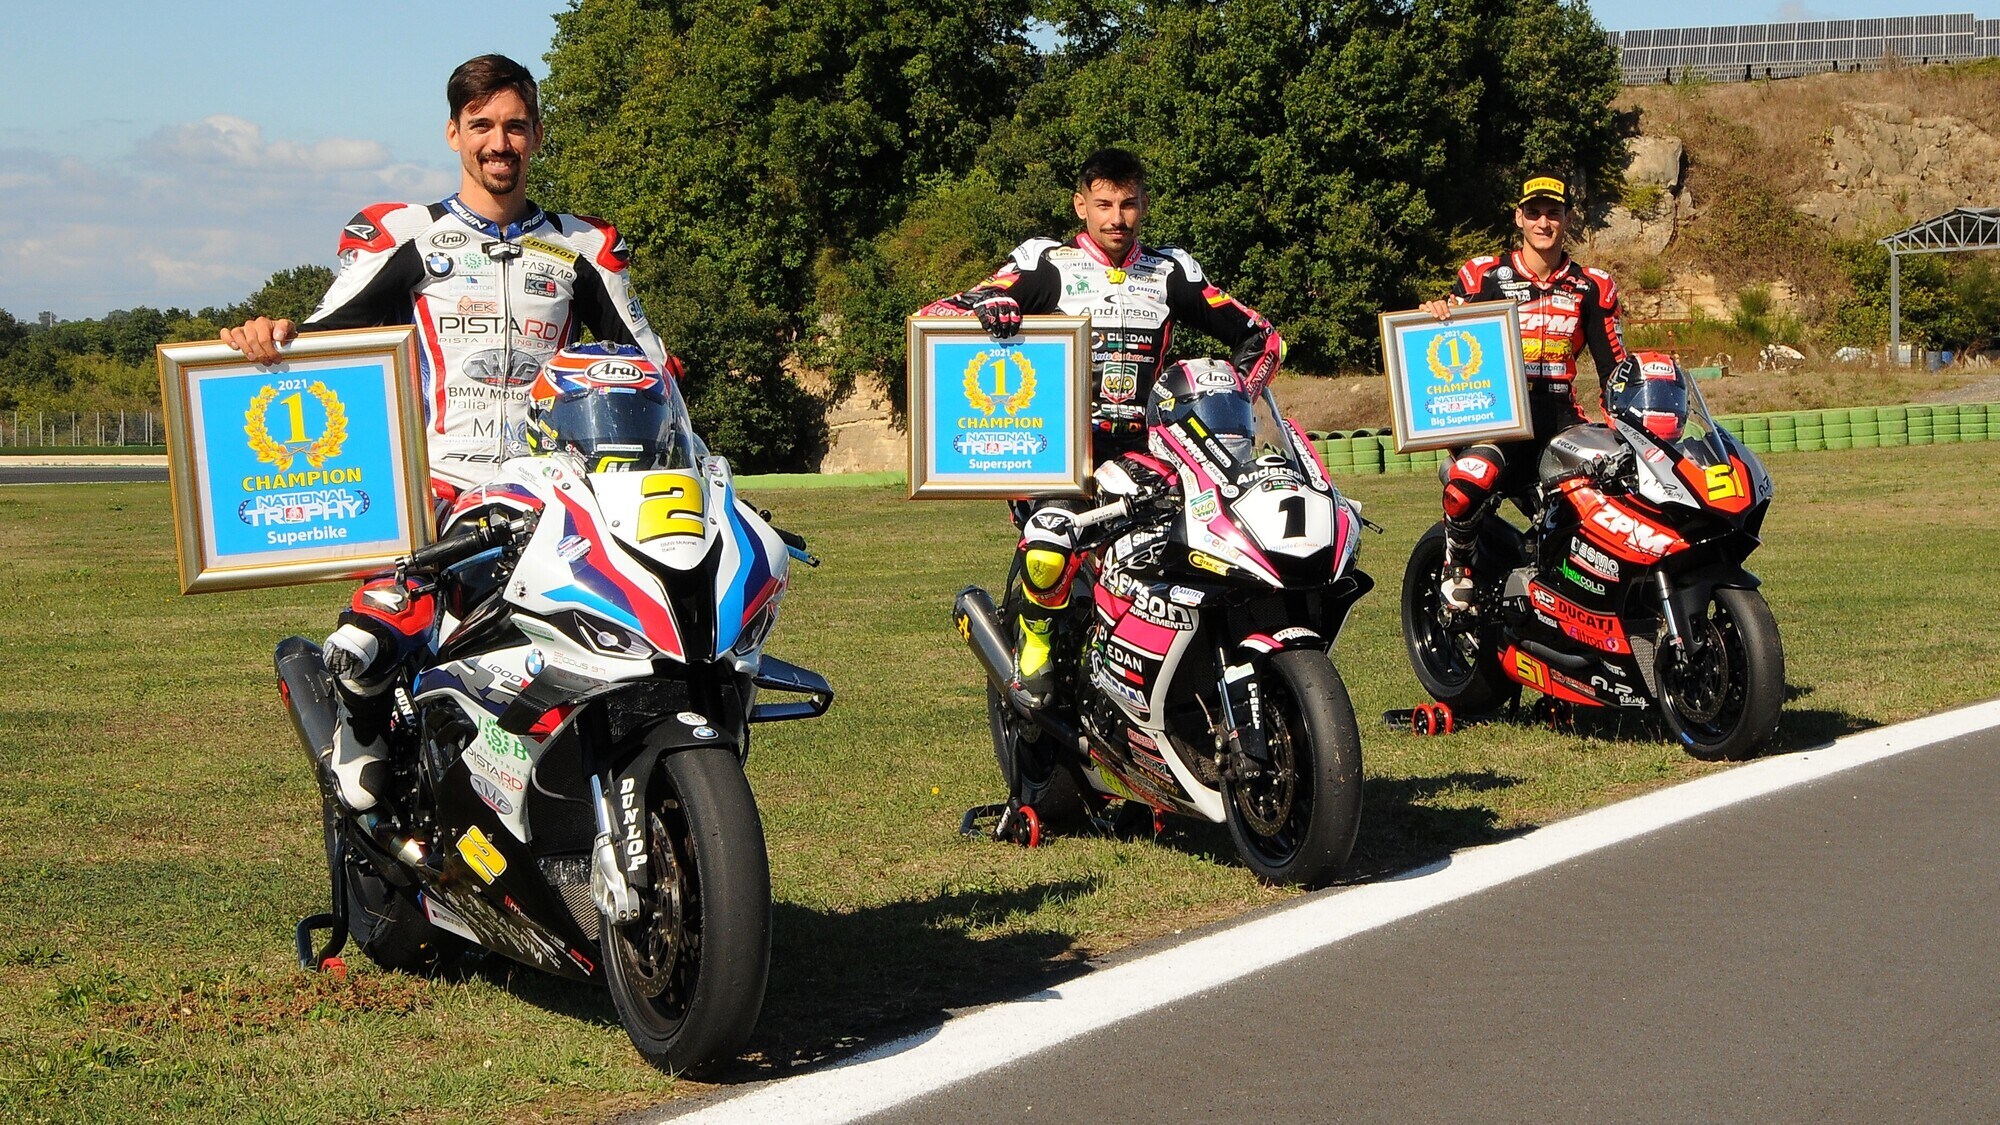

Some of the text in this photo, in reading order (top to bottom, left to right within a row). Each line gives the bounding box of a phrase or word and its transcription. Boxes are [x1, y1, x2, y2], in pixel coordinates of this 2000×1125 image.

[435, 234, 464, 246] Arai
[531, 240, 577, 262] DUNLOP
[521, 260, 574, 281] FASTLAP
[459, 303, 494, 313] MEK
[439, 316, 559, 341] PISTARD
[1443, 330, 1461, 338] 2021
[1518, 313, 1579, 334] ZPM
[486, 338, 532, 347] RAING
[1445, 338, 1464, 367] 1
[989, 349, 1011, 358] 2021
[590, 363, 639, 378] Arai
[990, 358, 1010, 396] 1
[1205, 373, 1233, 382] Arai
[1524, 364, 1565, 372] AVATORTA
[277, 379, 308, 391] 2021
[448, 387, 530, 401] BMW Motor
[1427, 380, 1491, 395] CHAMPION
[1434, 392, 1487, 404] NATIONAL
[280, 392, 313, 444] 1
[957, 417, 1044, 429] CHAMPION
[1430, 412, 1495, 427] Big Supersport
[966, 432, 1035, 442] NATIONAL
[957, 441, 1042, 455] TROPHY
[968, 458, 1032, 471] Supersport
[241, 467, 363, 492] CHAMPION
[1236, 466, 1305, 485] Anderson
[1705, 464, 1745, 502] 51
[255, 488, 354, 508] NATIONAL
[636, 473, 706, 543] 2
[245, 499, 363, 527] TROPHY
[1278, 495, 1307, 539] 1
[266, 525, 348, 546] Superbike
[1591, 503, 1676, 553] ZPM
[1571, 536, 1619, 574] DESMO
[1558, 602, 1614, 633] DUCATI
[1515, 651, 1545, 688] 51
[465, 747, 524, 791] PISTARD
[619, 777, 649, 873] DUNLOP
[455, 825, 508, 886] 2
